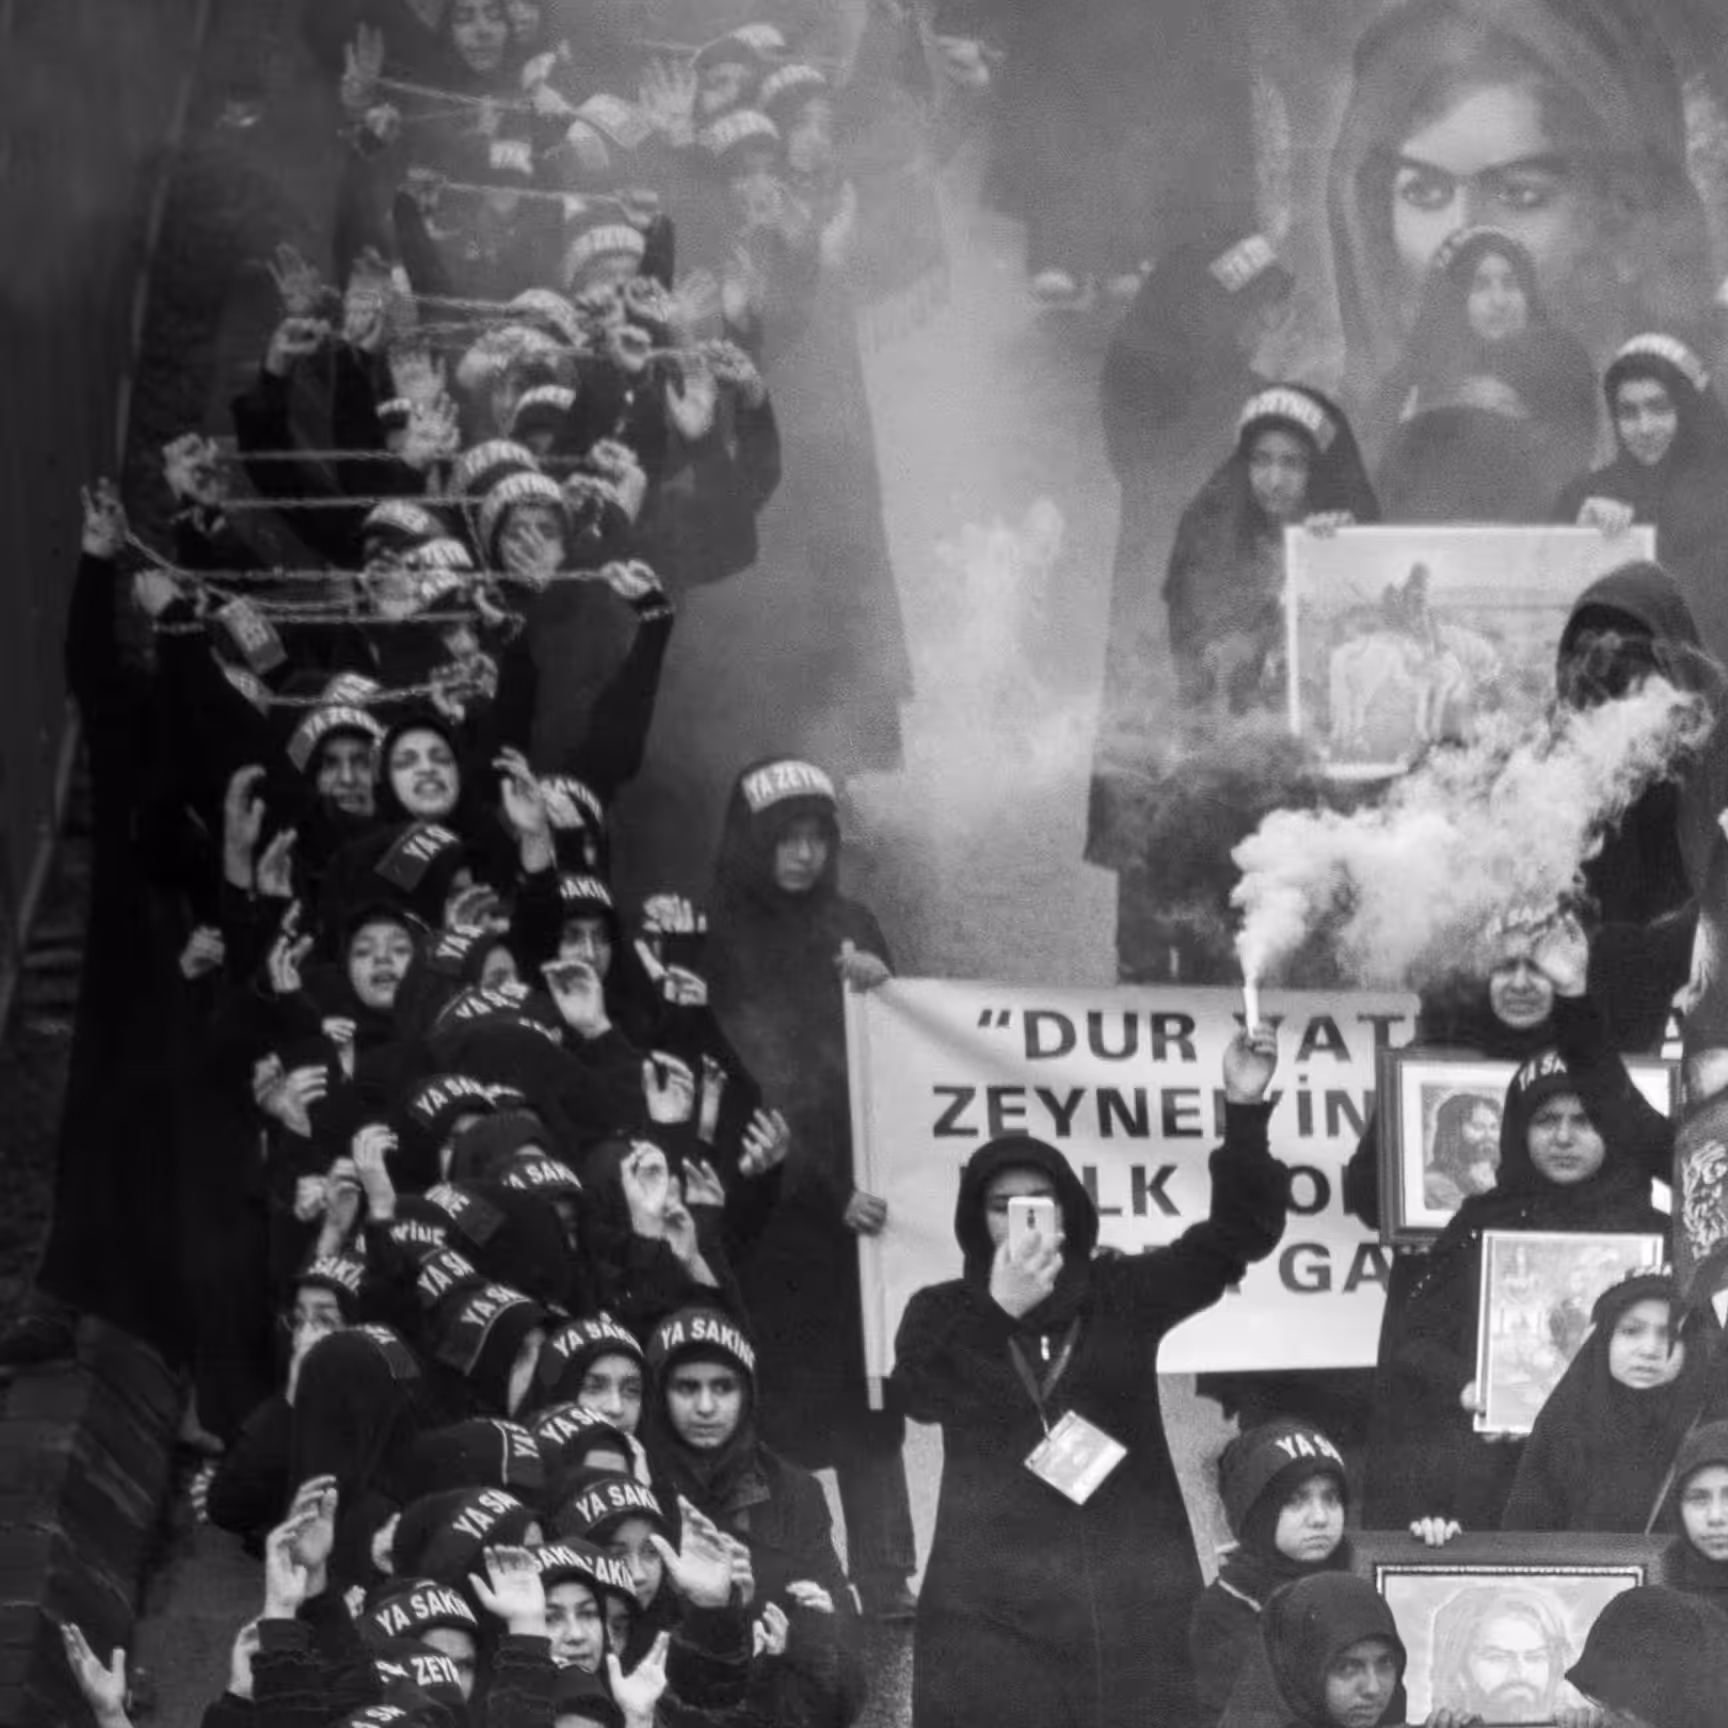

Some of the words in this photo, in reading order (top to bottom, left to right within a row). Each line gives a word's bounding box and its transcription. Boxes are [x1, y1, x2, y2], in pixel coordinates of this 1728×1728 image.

[417, 1264, 452, 1297] YA
[461, 1300, 496, 1327] YA
[553, 1329, 584, 1358] YA
[661, 1321, 685, 1350] YA
[540, 1414, 579, 1446] YA
[1276, 1435, 1315, 1462] YA
[452, 1506, 496, 1540] YA
[576, 1492, 608, 1523] YA
[375, 1604, 411, 1637] YA
